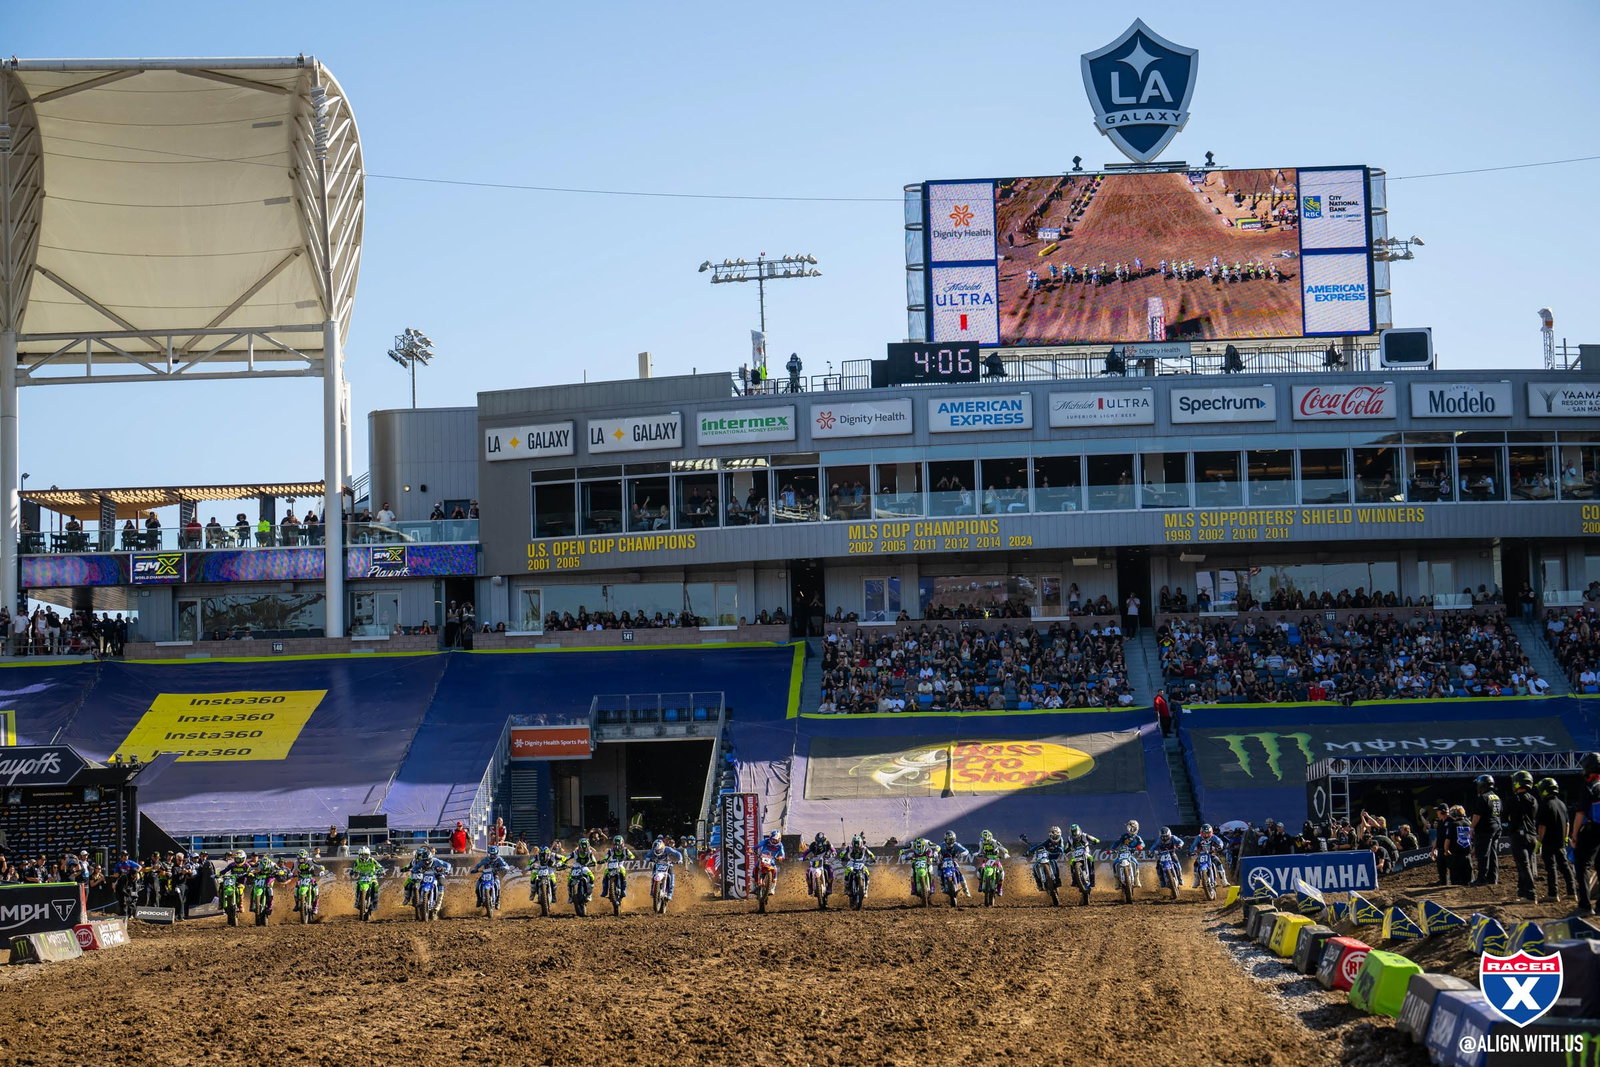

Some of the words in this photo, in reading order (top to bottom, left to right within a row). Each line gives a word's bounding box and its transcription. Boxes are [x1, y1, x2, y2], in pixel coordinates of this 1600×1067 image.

[1110, 69, 1174, 105] LA
[1105, 112, 1181, 125] GALAXY
[933, 230, 963, 240] Dignity
[964, 229, 992, 238] Health
[1306, 284, 1365, 294] AMERICAN
[1315, 292, 1366, 302] EXPRESS
[935, 293, 994, 306] ULTRA
[914, 349, 973, 374] 4:06
[937, 399, 1022, 414] AMERICAN
[1055, 400, 1095, 411] Michelob
[1106, 398, 1150, 409] ULTRA
[1179, 396, 1260, 414] Spectrum
[1300, 386, 1388, 416] Coca-Cola
[1429, 390, 1495, 414] Modelo
[701, 415, 789, 432] intermex
[840, 414, 873, 426] Dignity
[874, 412, 905, 422] Health
[950, 412, 1024, 426] EXPRESS
[590, 427, 605, 445] LA
[633, 422, 677, 442] GALAXY
[701, 429, 747, 437] INTERNATIONAL
[488, 436, 501, 453] LA
[528, 430, 570, 450] GALAXY
[1164, 512, 1195, 528] MLS
[1302, 509, 1352, 525] SHIELD
[1357, 507, 1425, 523] WINNERS
[848, 524, 878, 541] MLS
[882, 522, 911, 539] CUP
[914, 518, 999, 537] CHAMPIONS
[1164, 529, 1191, 542] 1998
[1198, 528, 1225, 541] 2002
[1232, 527, 1258, 540] 2010
[1265, 526, 1289, 539] 2011
[527, 542, 549, 558] U.S.
[552, 540, 585, 557] OPEN
[589, 538, 615, 555] CUP
[618, 534, 696, 553] CHAMPIONS
[848, 541, 874, 553] 2002
[881, 540, 906, 552] 2005
[913, 538, 936, 551] 2011
[944, 537, 969, 550] 2012
[976, 536, 1001, 549] 2014
[1008, 535, 1033, 547] 2024
[373, 550, 403, 562] SMX
[527, 558, 550, 571] 2001
[556, 556, 580, 569] 2005
[134, 557, 179, 575] SMX
[189, 695, 286, 706] Insta360
[177, 712, 275, 723] Insta360
[163, 729, 263, 741] Insta360
[952, 742, 1044, 757] Bass
[1326, 734, 1558, 753] MONSTER
[151, 747, 252, 758] Ista360
[0, 752, 61, 786] ayoffs
[952, 755, 1023, 770] Pro
[952, 767, 1069, 786] Shops
[725, 797, 734, 852] MOUNTAIN
[725, 852, 734, 883] ROCKY
[1275, 863, 1371, 891] YAMAHA
[0, 903, 50, 921] MPH
[136, 909, 169, 917] peacock
